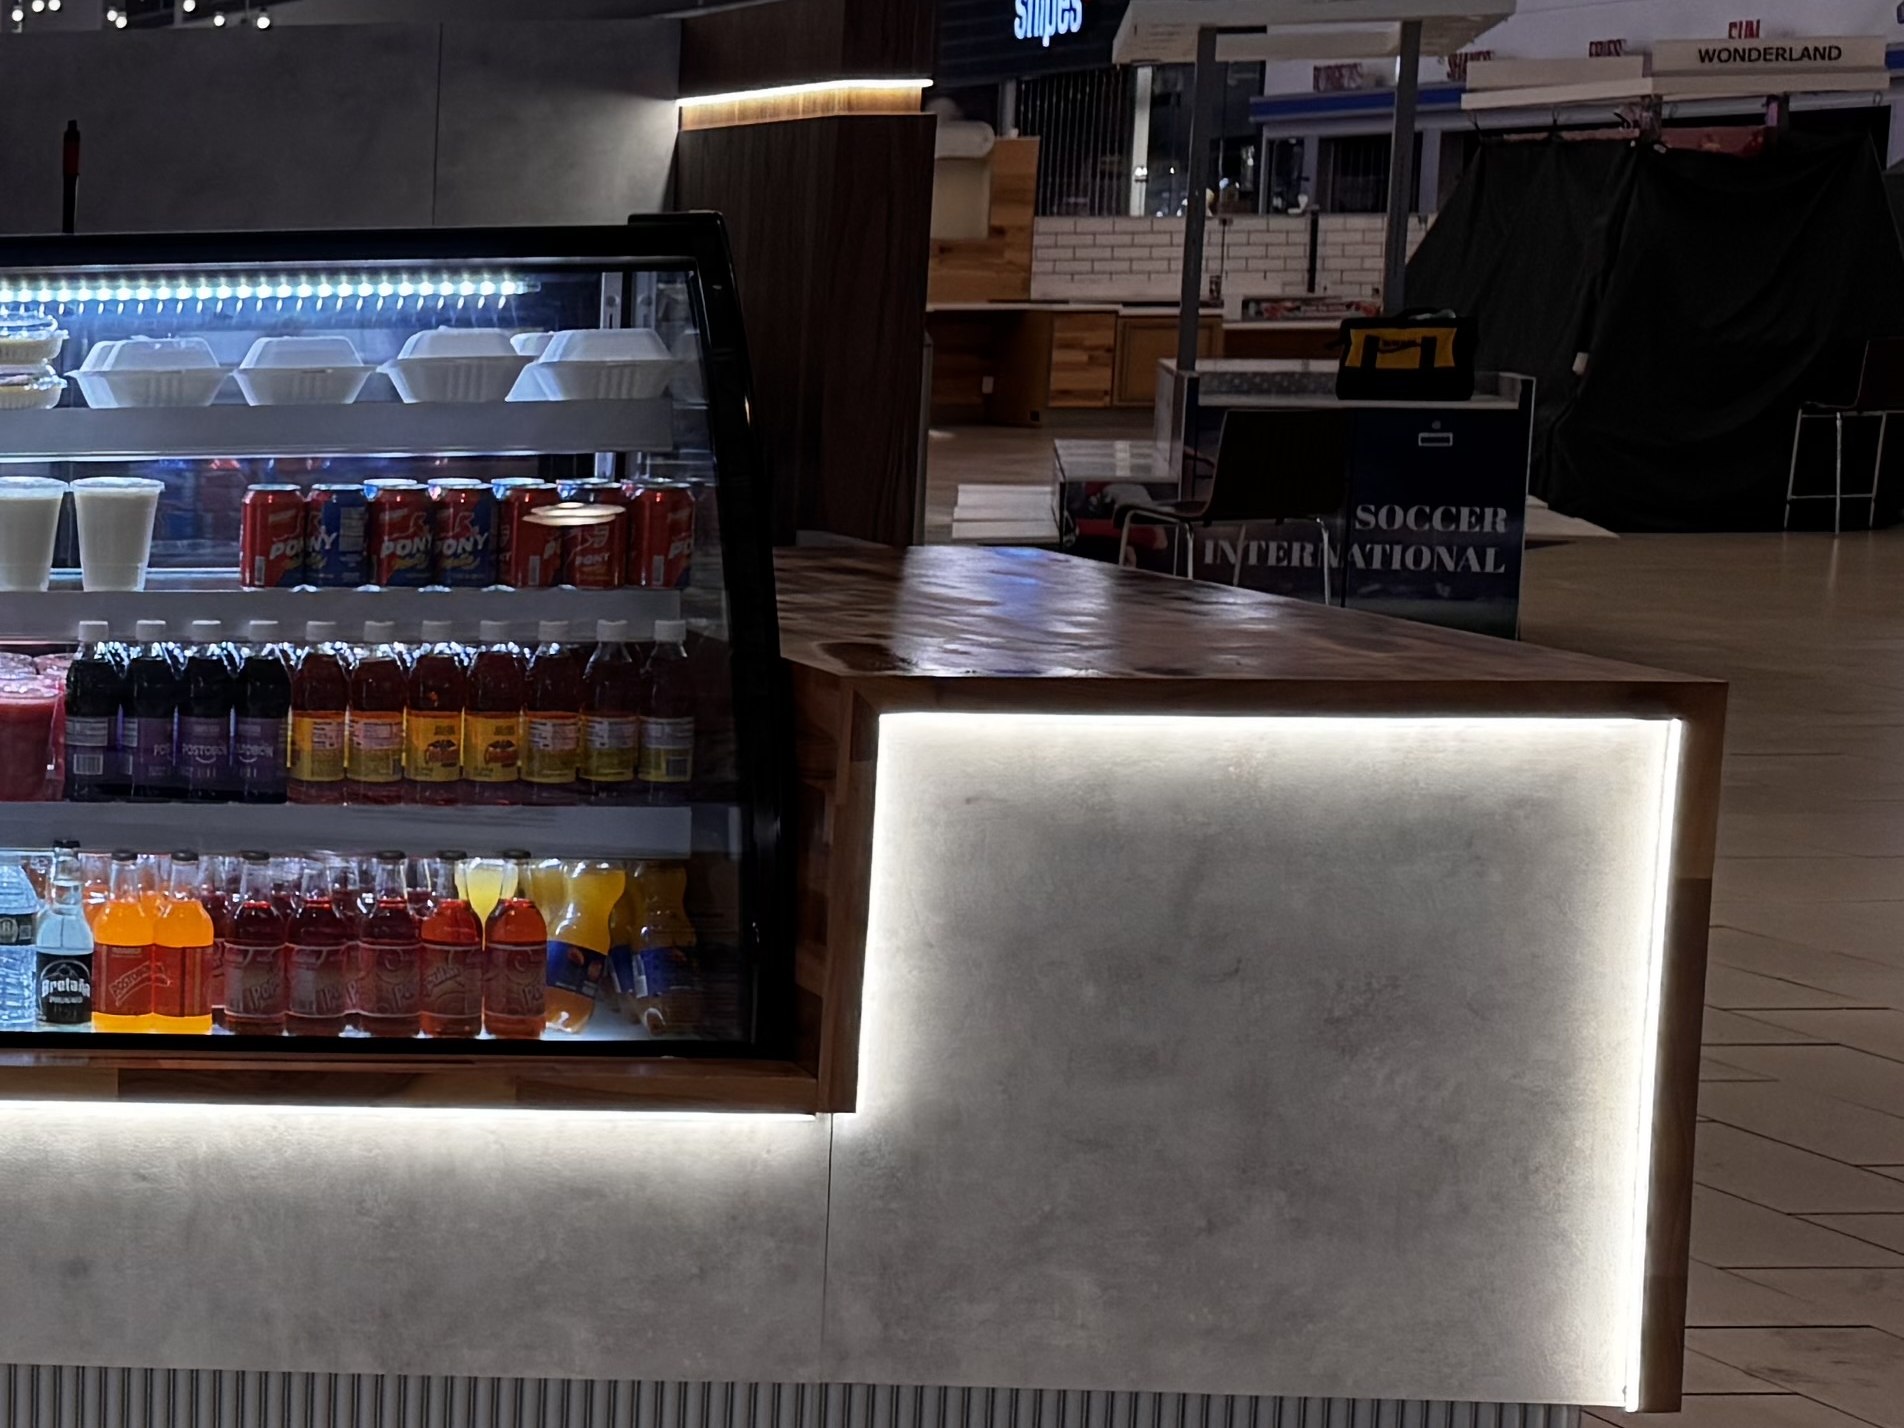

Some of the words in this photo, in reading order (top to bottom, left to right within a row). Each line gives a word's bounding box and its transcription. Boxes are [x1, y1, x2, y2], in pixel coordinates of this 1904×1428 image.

[1698, 45, 1842, 64] WONDERLAND
[1353, 503, 1509, 534] SOCCER
[269, 539, 304, 560] PO
[1203, 539, 1507, 574] INTERNATIONAL
